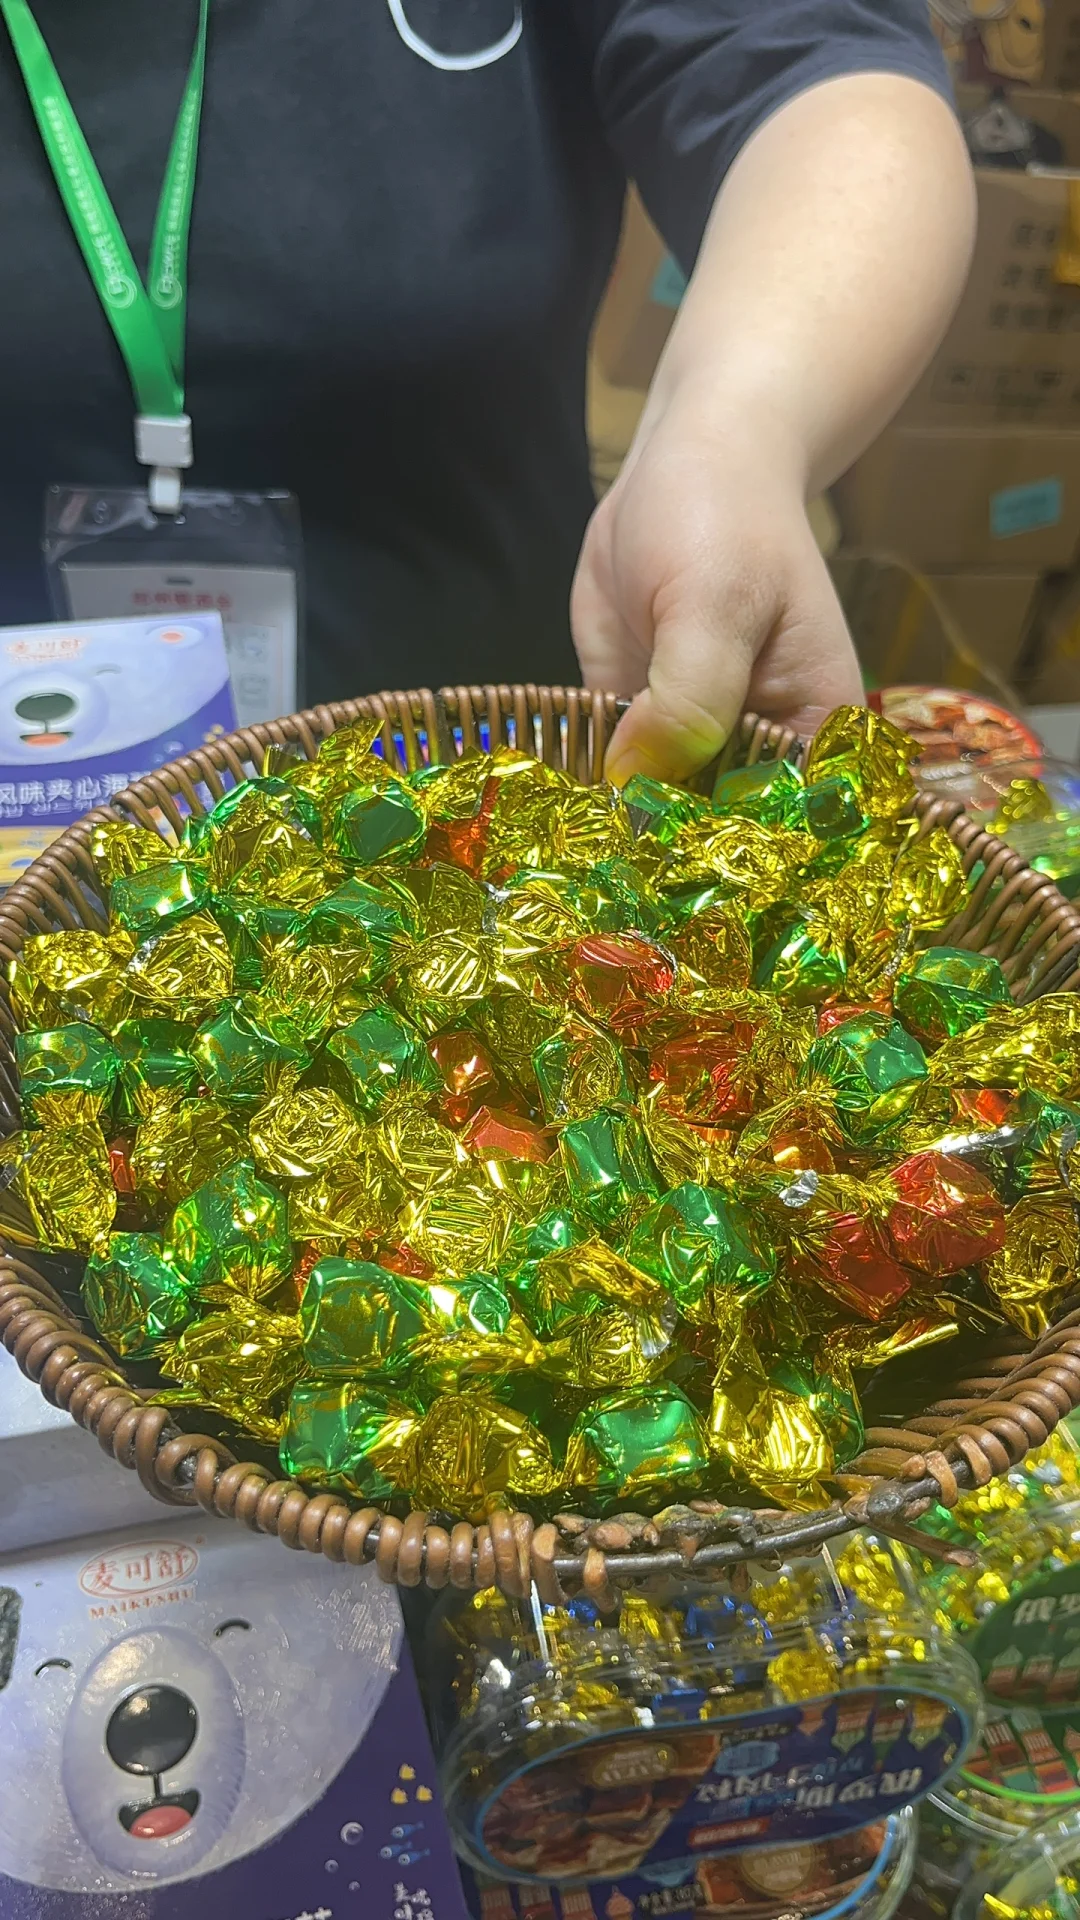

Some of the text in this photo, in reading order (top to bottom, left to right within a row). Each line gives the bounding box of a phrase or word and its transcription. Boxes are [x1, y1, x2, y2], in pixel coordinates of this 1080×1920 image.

[0, 773, 152, 805] 风味夹心海
